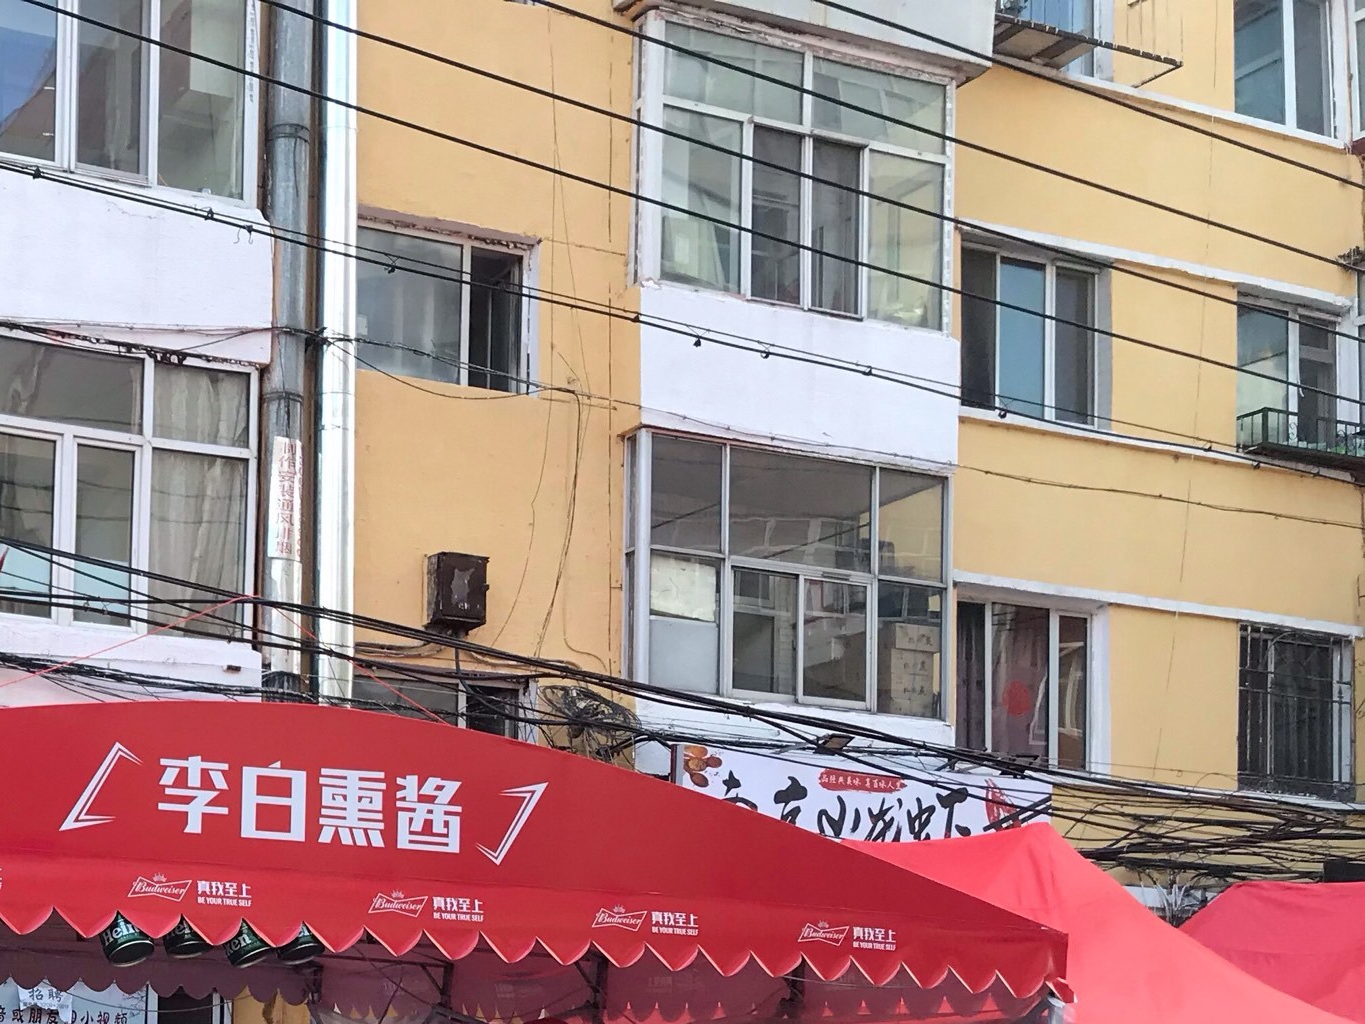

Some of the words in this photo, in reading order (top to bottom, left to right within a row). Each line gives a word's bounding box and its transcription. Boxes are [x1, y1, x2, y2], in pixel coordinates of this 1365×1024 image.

[157, 755, 462, 853] 李白熏酱
[132, 882, 185, 894] Budweiser
[197, 880, 251, 898] 真我至上
[207, 897, 222, 905] YOUR
[223, 898, 238, 906] TRUE
[238, 899, 251, 907] SELF
[373, 898, 422, 910] Budweiser
[433, 896, 484, 914] 真我至上
[596, 912, 641, 924] Budweiser
[651, 911, 699, 928] 真我至上
[802, 927, 844, 939] Budweiser
[853, 926, 896, 943] 真我至上
[28, 987, 64, 1003] 招聘
